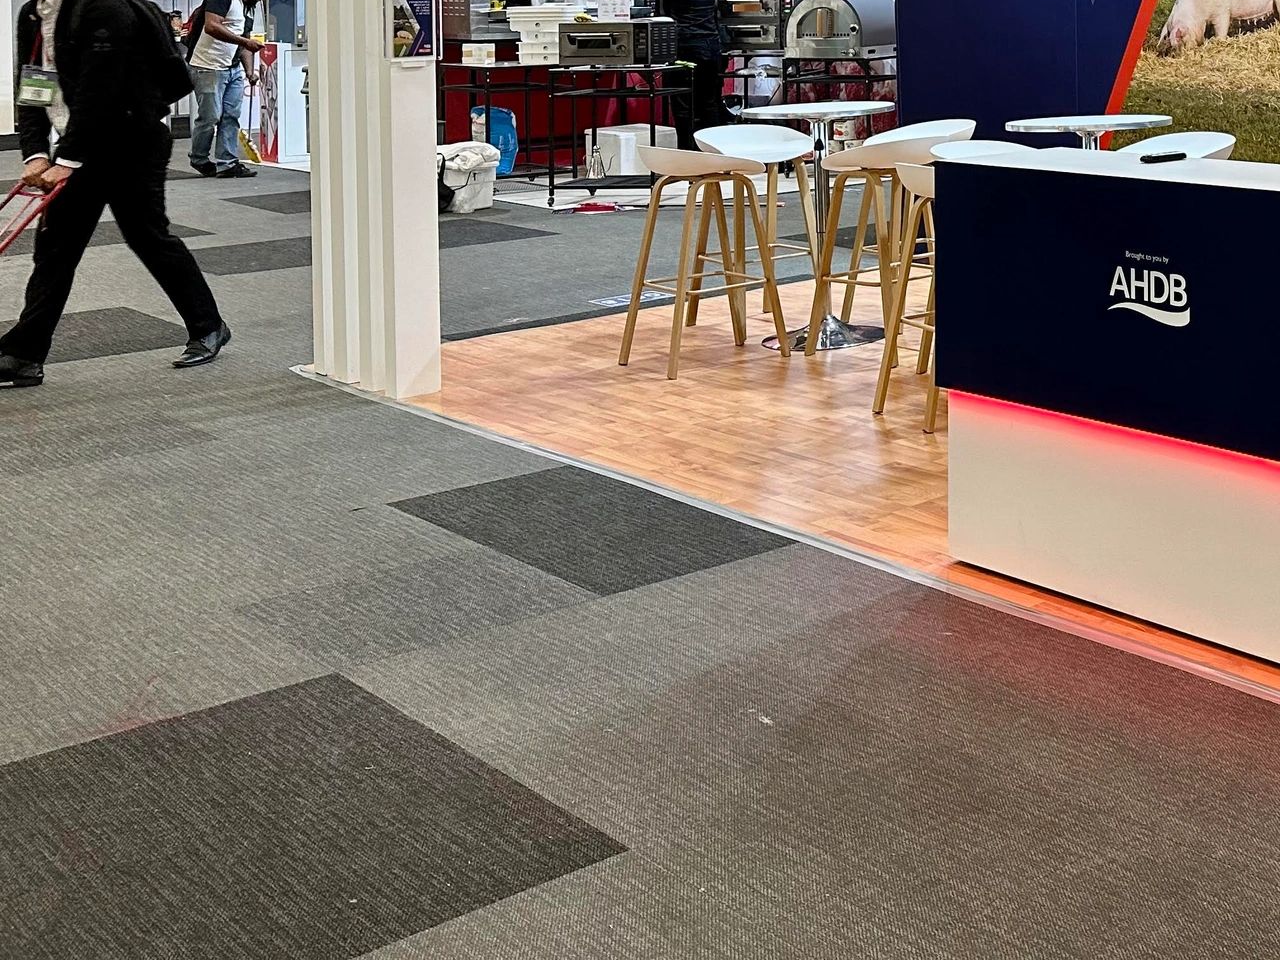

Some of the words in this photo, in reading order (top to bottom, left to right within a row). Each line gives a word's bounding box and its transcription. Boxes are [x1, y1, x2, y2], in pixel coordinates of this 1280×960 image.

[1125, 249, 1145, 261] Brought
[1145, 253, 1152, 261] to
[1152, 255, 1162, 263] you
[1162, 256, 1169, 265] by
[1109, 265, 1188, 307] AHDB
